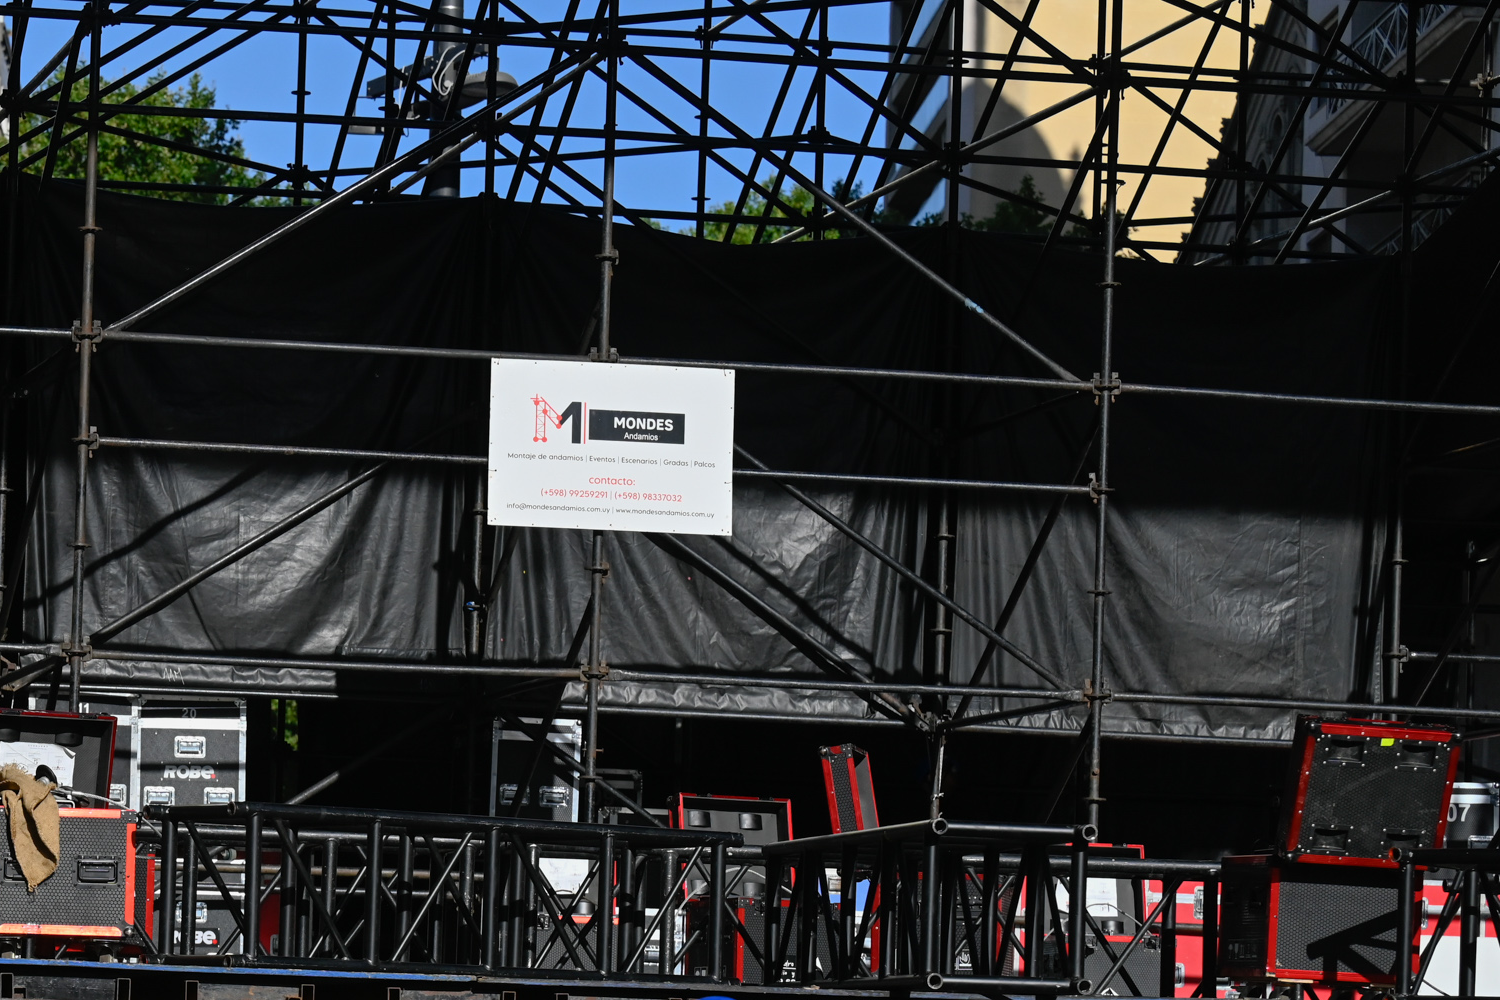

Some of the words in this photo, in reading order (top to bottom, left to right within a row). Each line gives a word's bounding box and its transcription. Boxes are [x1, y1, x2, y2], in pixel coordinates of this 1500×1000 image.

[613, 417, 674, 431] MONDES
[623, 432, 659, 441] Andamios
[507, 453, 536, 461] Montaje
[589, 455, 616, 463] Eventos
[621, 457, 658, 465] Escenarios
[663, 459, 689, 467] Gradas
[588, 477, 636, 486] contacto:
[540, 488, 567, 497] (+598)
[569, 489, 608, 498] 99259291
[614, 491, 641, 501] (+598)
[642, 493, 683, 502] 98337032
[506, 502, 611, 514] info@mondesandamios.com.uy
[615, 507, 715, 518] www.mondesandamios.com.uy
[182, 707, 197, 719] 20
